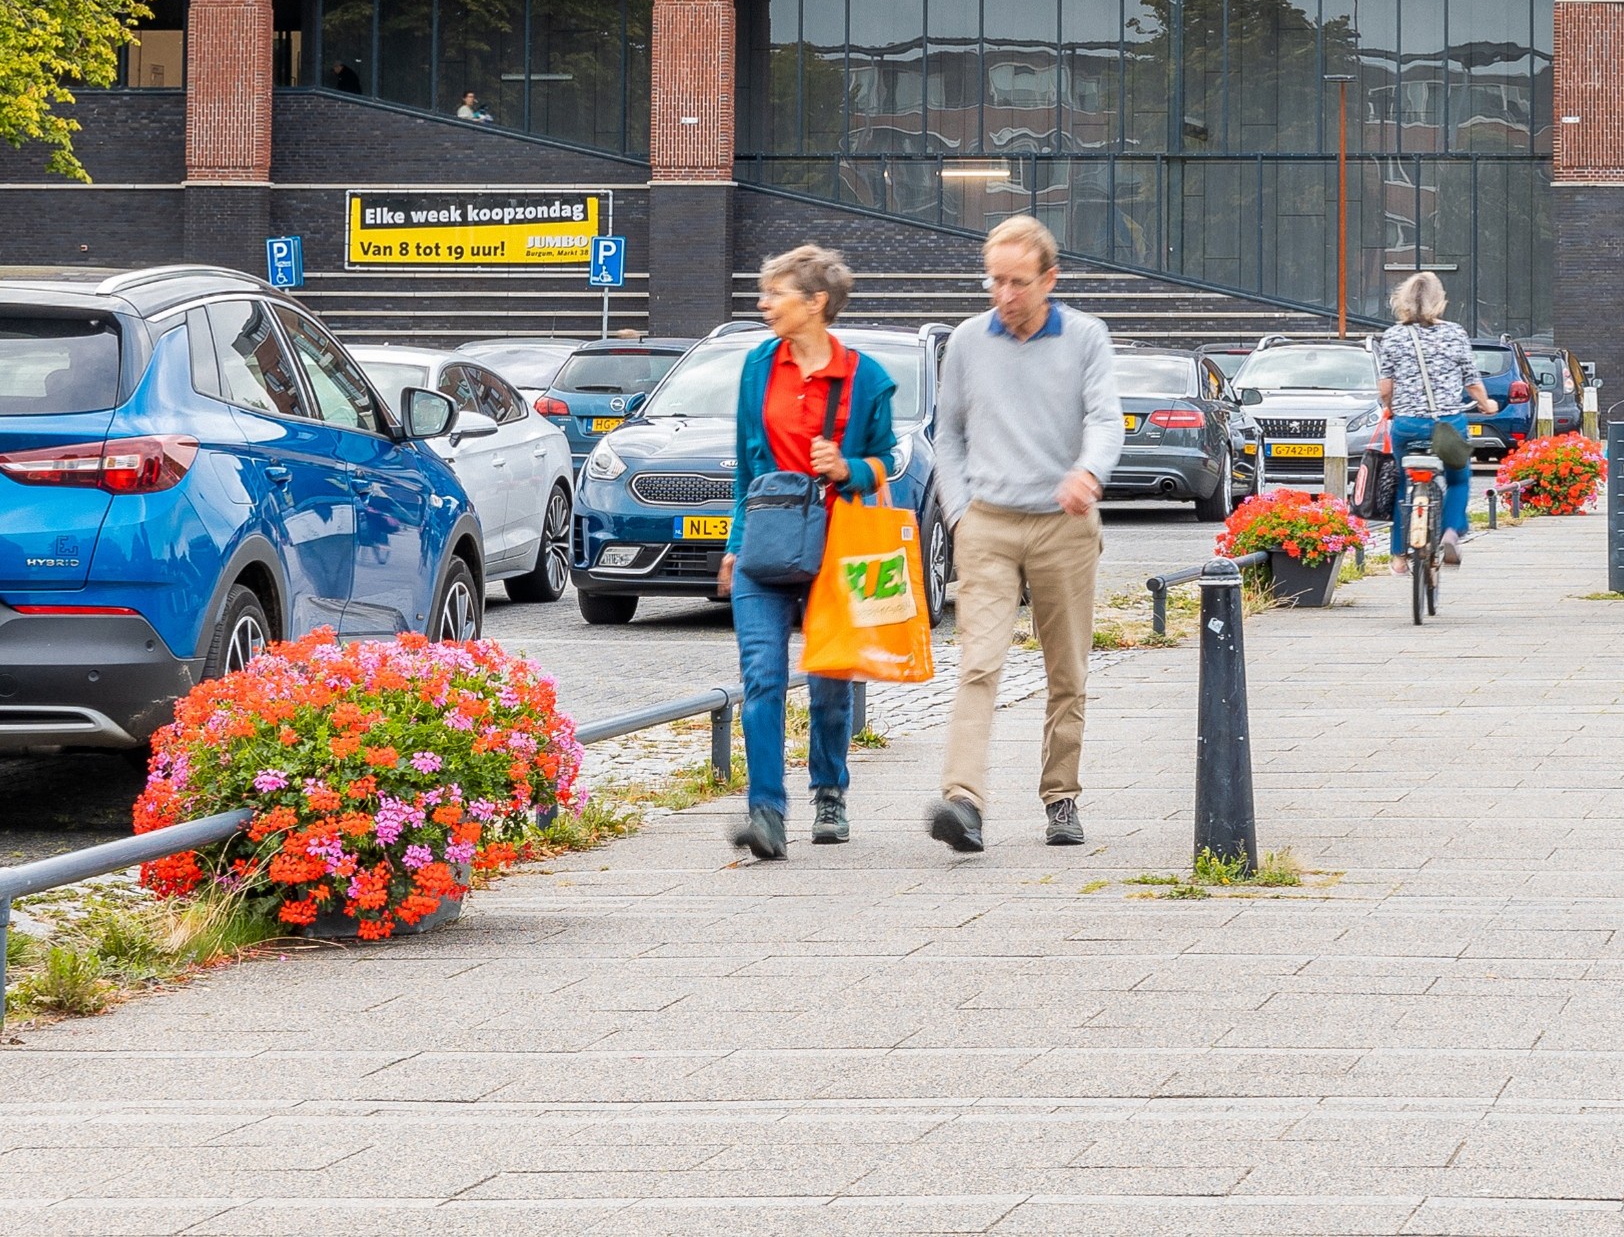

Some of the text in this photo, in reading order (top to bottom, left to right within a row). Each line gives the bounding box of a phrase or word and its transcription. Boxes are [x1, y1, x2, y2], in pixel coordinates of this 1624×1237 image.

[365, 201, 585, 225] Elke week koopzondag
[526, 235, 589, 249] JUMBO
[273, 243, 287, 263] P
[359, 242, 505, 260] Van 8 tot 19 uur!
[598, 241, 617, 264] P
[1275, 446, 1319, 455] G-742-PP
[690, 520, 728, 535] NL-3
[26, 558, 80, 567] HYBRID
